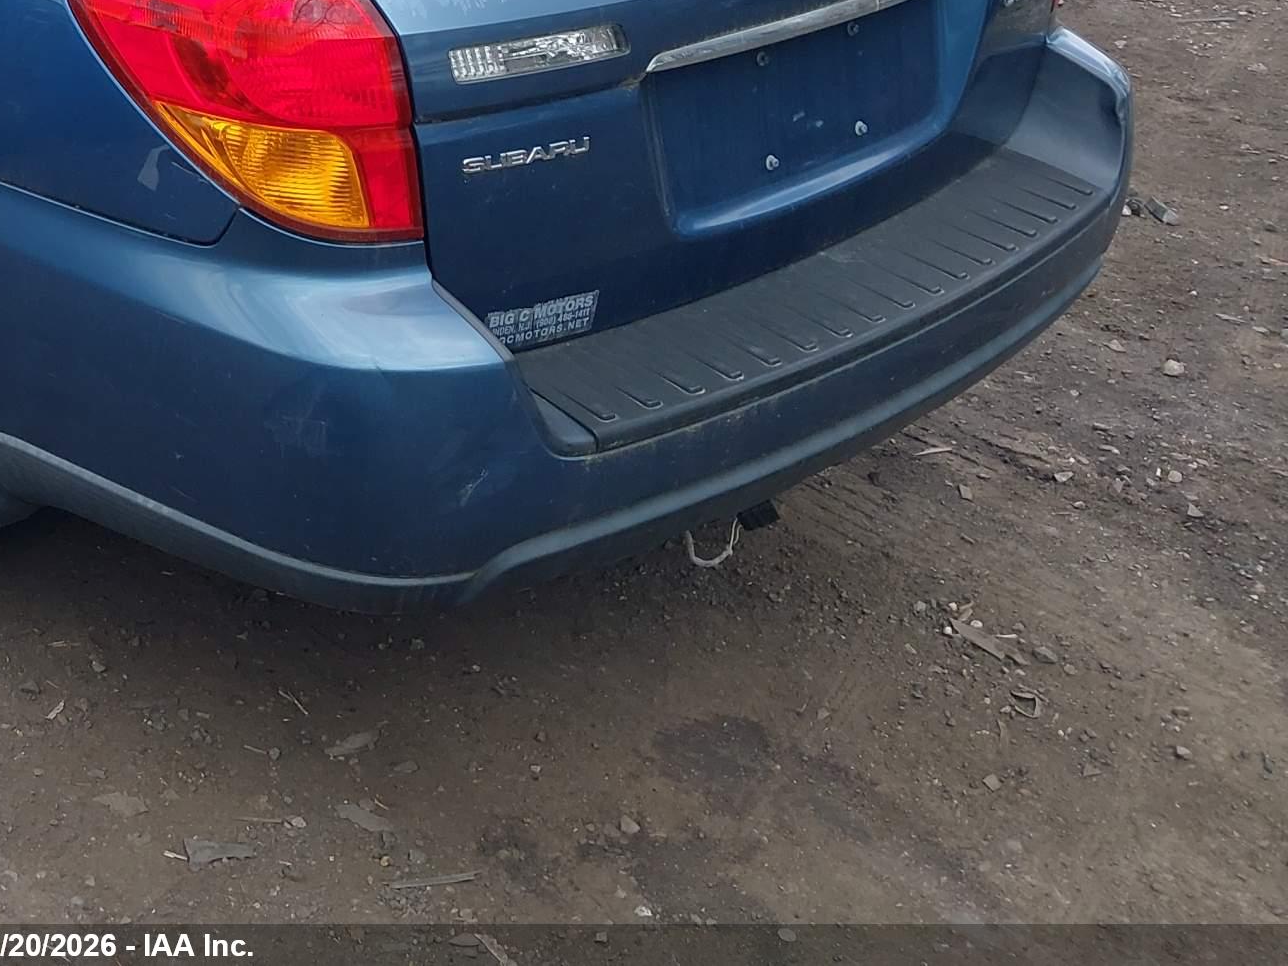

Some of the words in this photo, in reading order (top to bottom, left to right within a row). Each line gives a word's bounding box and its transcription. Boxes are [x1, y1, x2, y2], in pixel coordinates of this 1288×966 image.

[462, 136, 590, 173] SUBARU
[489, 313, 514, 328] BIG
[519, 310, 530, 322] C
[534, 296, 594, 319] MOTORS
